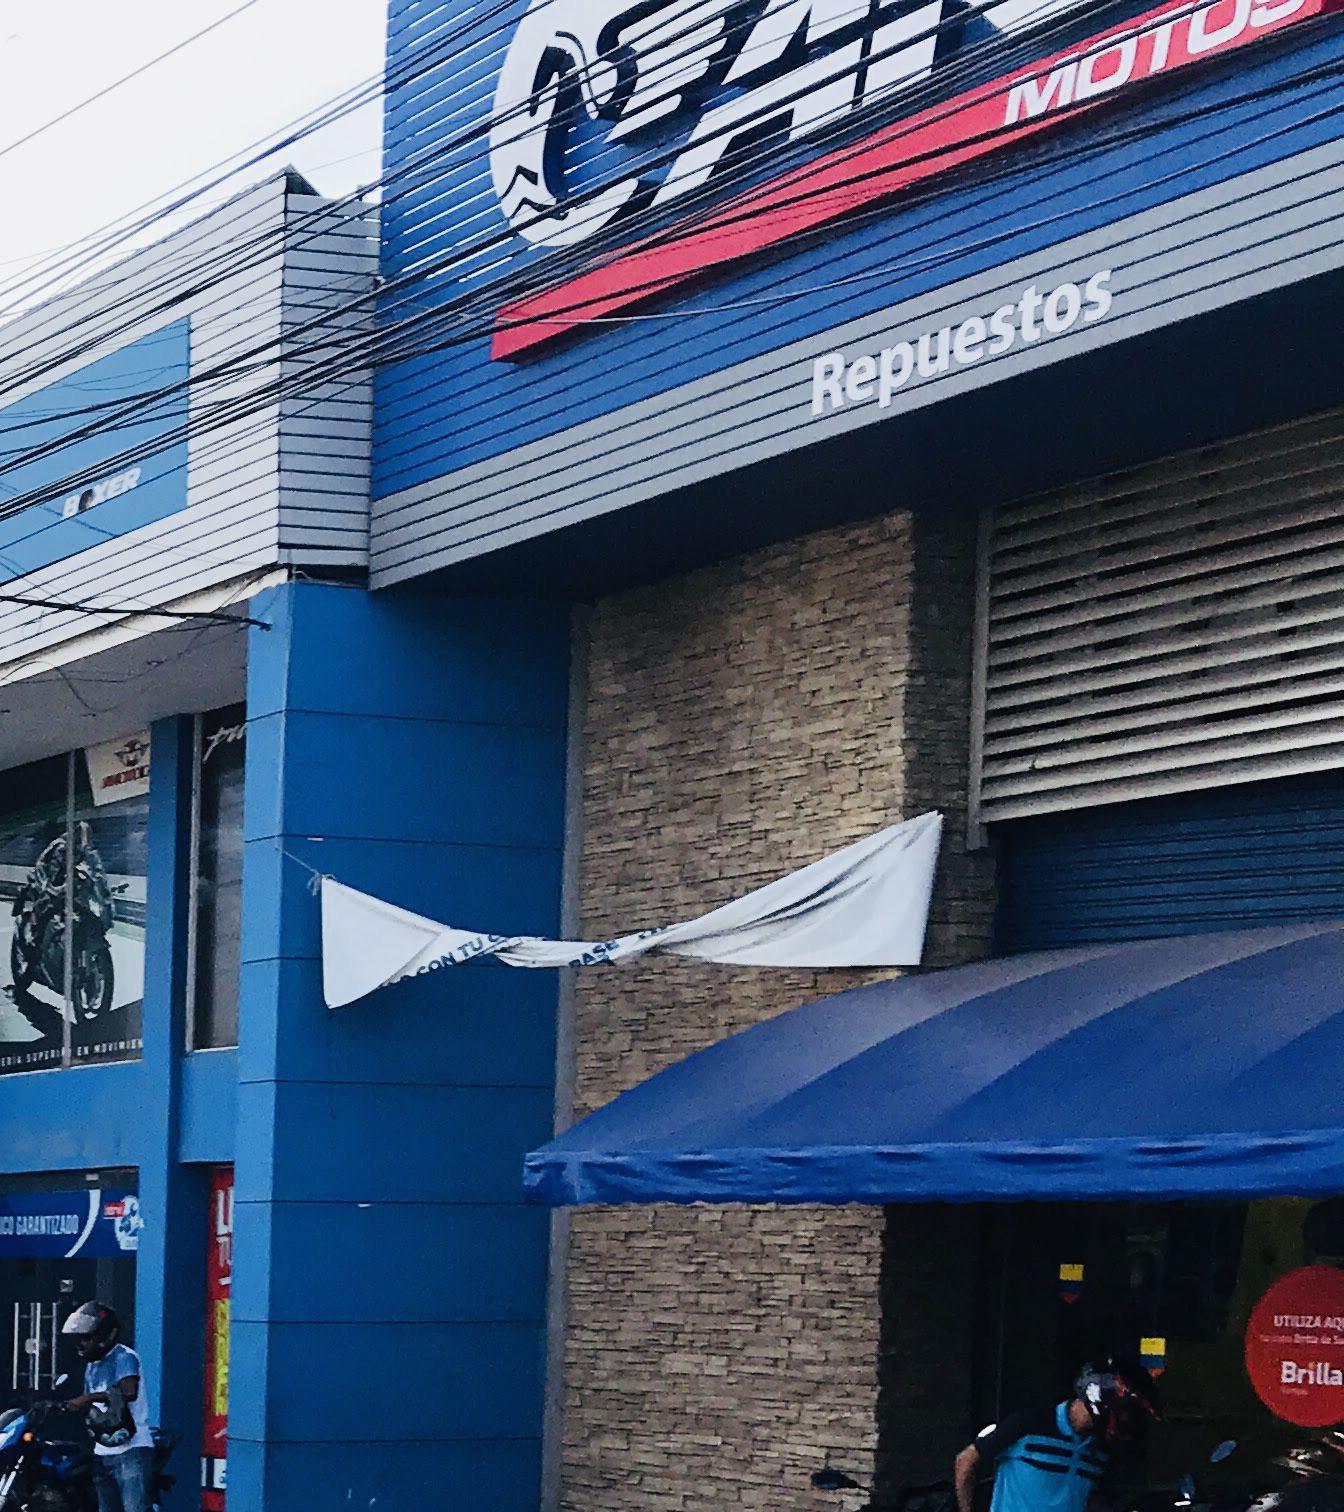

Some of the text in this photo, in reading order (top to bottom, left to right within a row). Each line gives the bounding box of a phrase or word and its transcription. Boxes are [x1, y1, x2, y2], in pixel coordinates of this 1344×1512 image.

[812, 270, 1113, 416] Repuestos
[15, 1214, 79, 1236] GARANTIZADO
[1273, 1314, 1322, 1328] UTILIZA
[1280, 1360, 1343, 1386] Brilla
